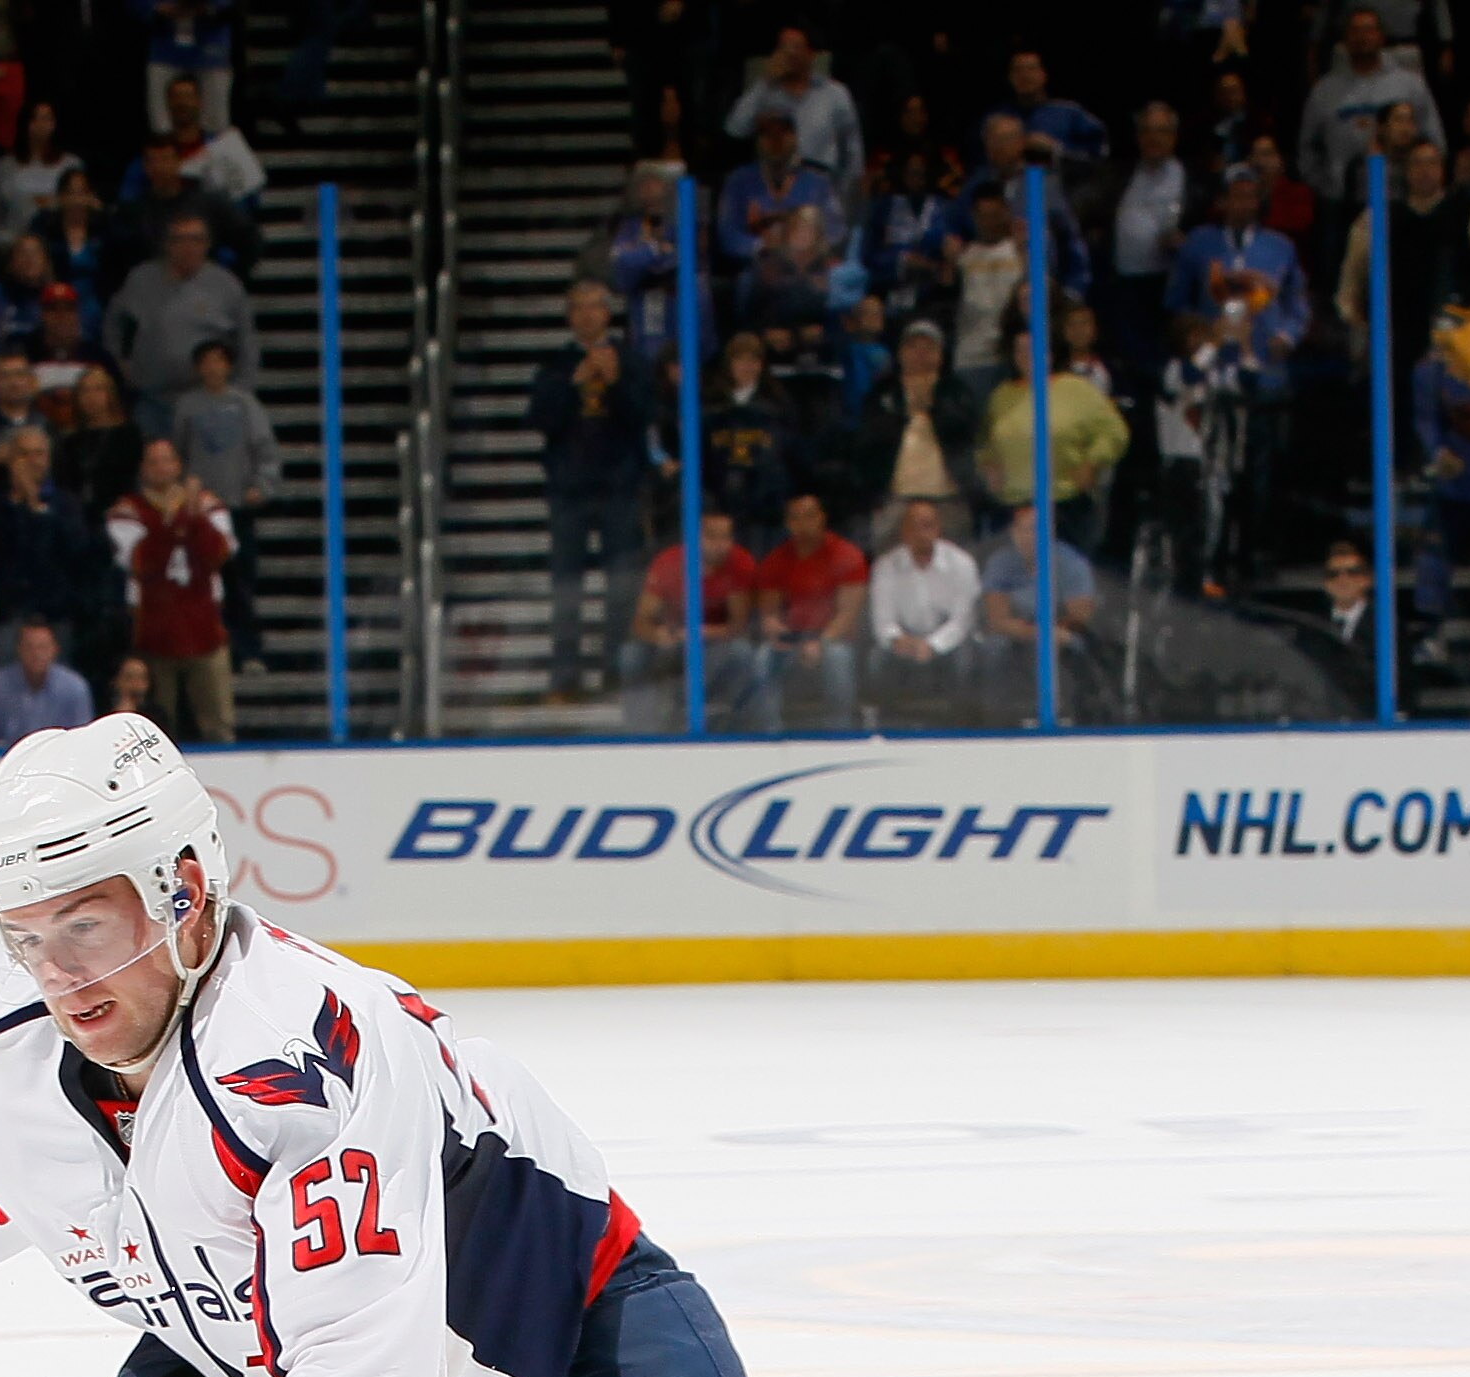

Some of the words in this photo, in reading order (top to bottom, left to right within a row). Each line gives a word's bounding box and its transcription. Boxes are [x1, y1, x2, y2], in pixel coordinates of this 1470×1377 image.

[165, 545, 193, 588] 4
[389, 800, 677, 861] BUD
[741, 798, 1112, 862] LIGHT
[288, 1147, 401, 1273] 52
